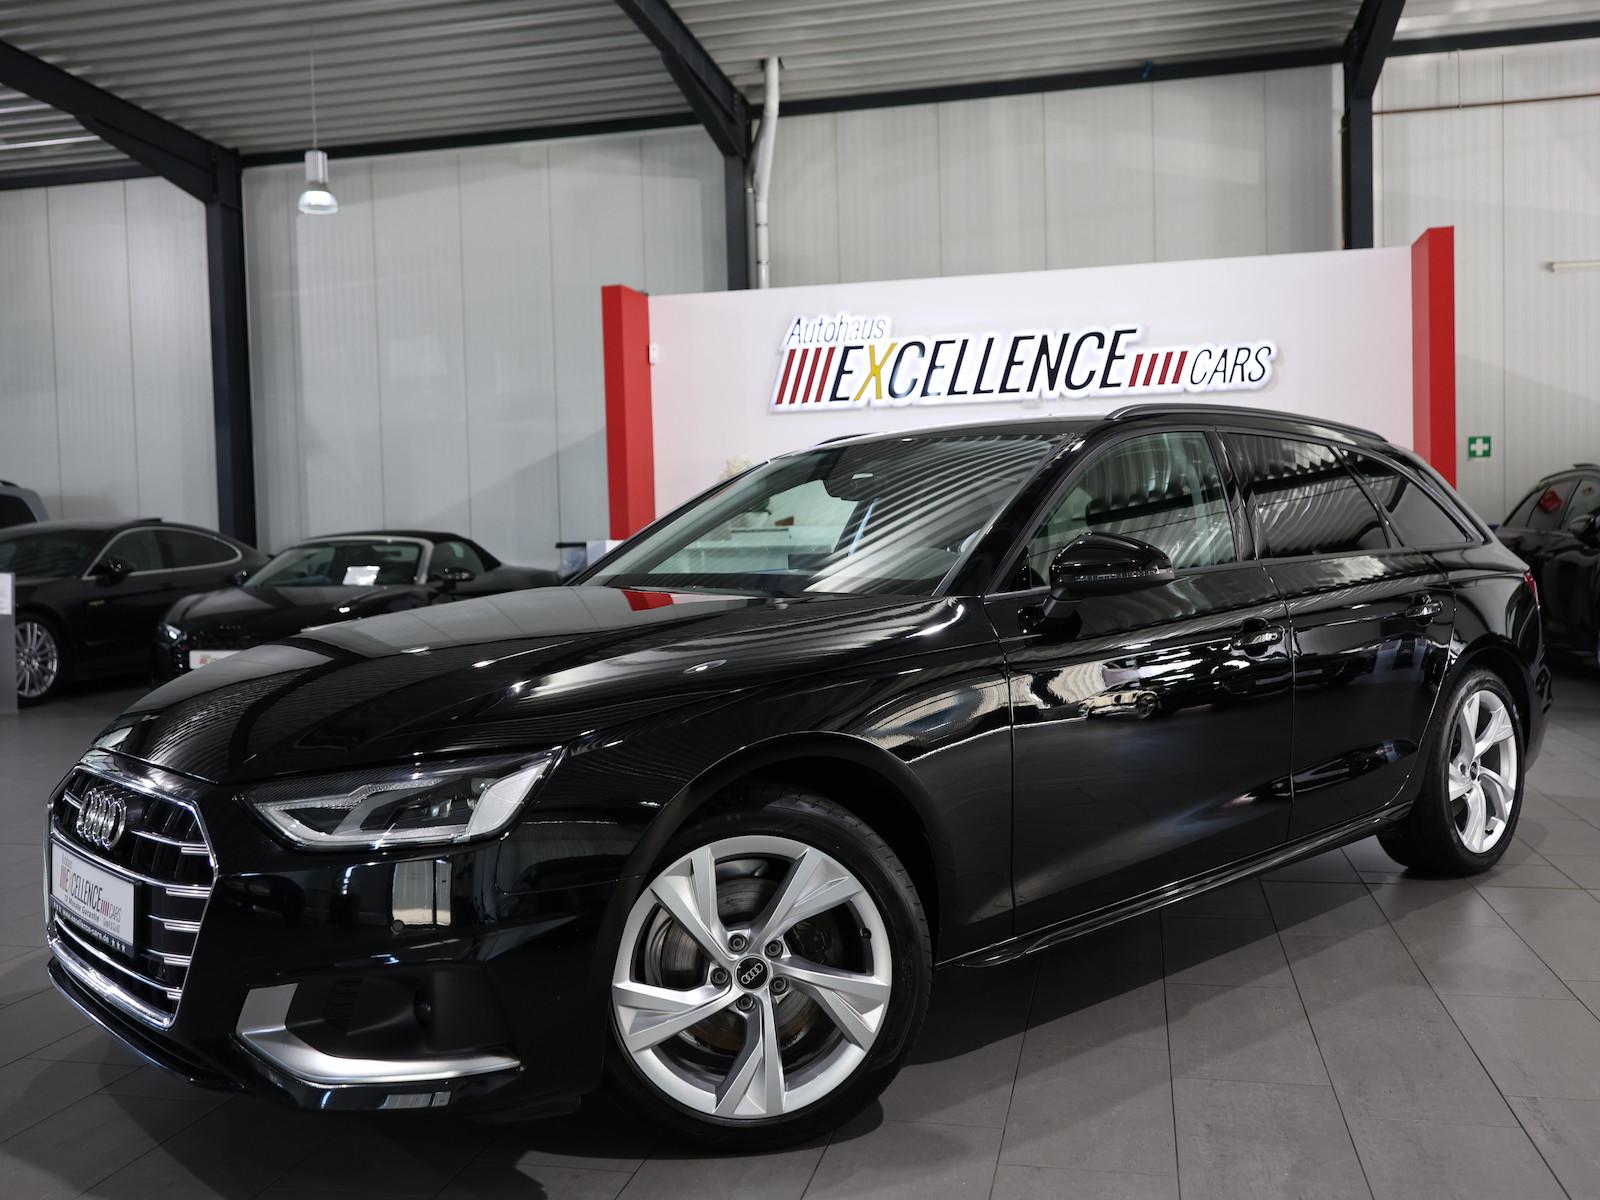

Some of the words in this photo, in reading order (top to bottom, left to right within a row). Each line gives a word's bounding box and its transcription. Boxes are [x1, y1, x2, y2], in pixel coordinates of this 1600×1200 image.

[787, 315, 887, 345] Autohaus
[828, 328, 1138, 402] EXCELLENCE
[1190, 345, 1272, 385] CARS
[65, 870, 103, 912] EXCELLENCE
